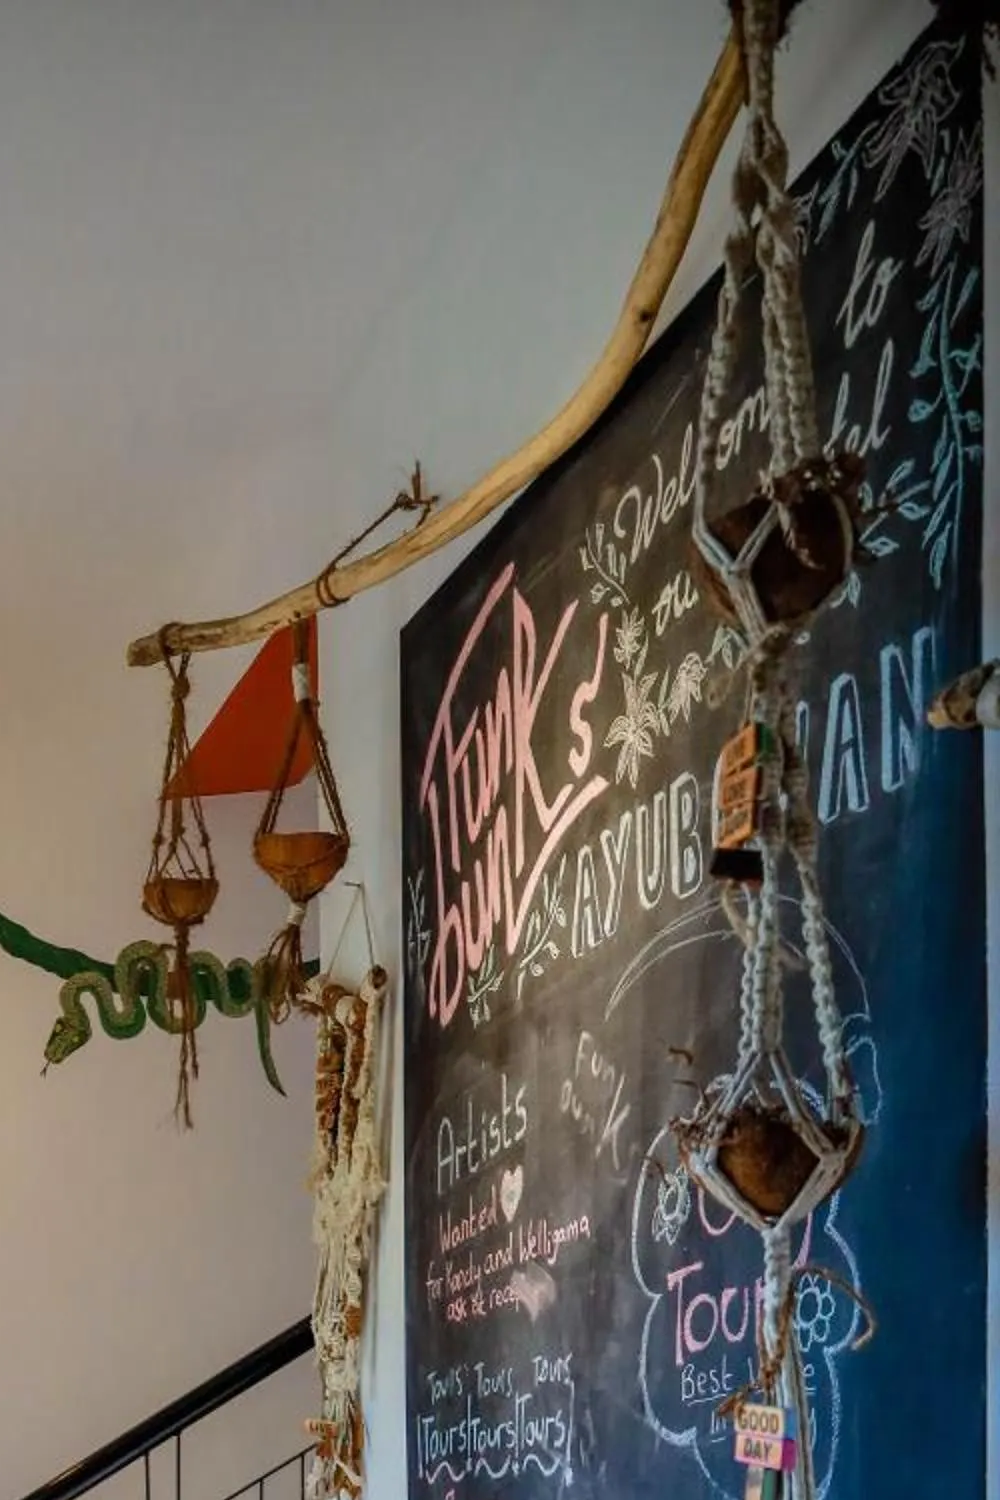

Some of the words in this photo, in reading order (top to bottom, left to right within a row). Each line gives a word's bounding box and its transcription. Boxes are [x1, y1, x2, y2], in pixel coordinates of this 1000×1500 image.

[835, 219, 904, 349] to
[652, 569, 700, 636] ou
[571, 626, 938, 959] AYUBAN
[436, 1073, 528, 1194] Artists
[439, 1184, 498, 1252] Wanted
[483, 1231, 524, 1274] and
[681, 1353, 734, 1402] Best
[737, 1408, 780, 1434] GOOD
[743, 1439, 773, 1462] DAY
